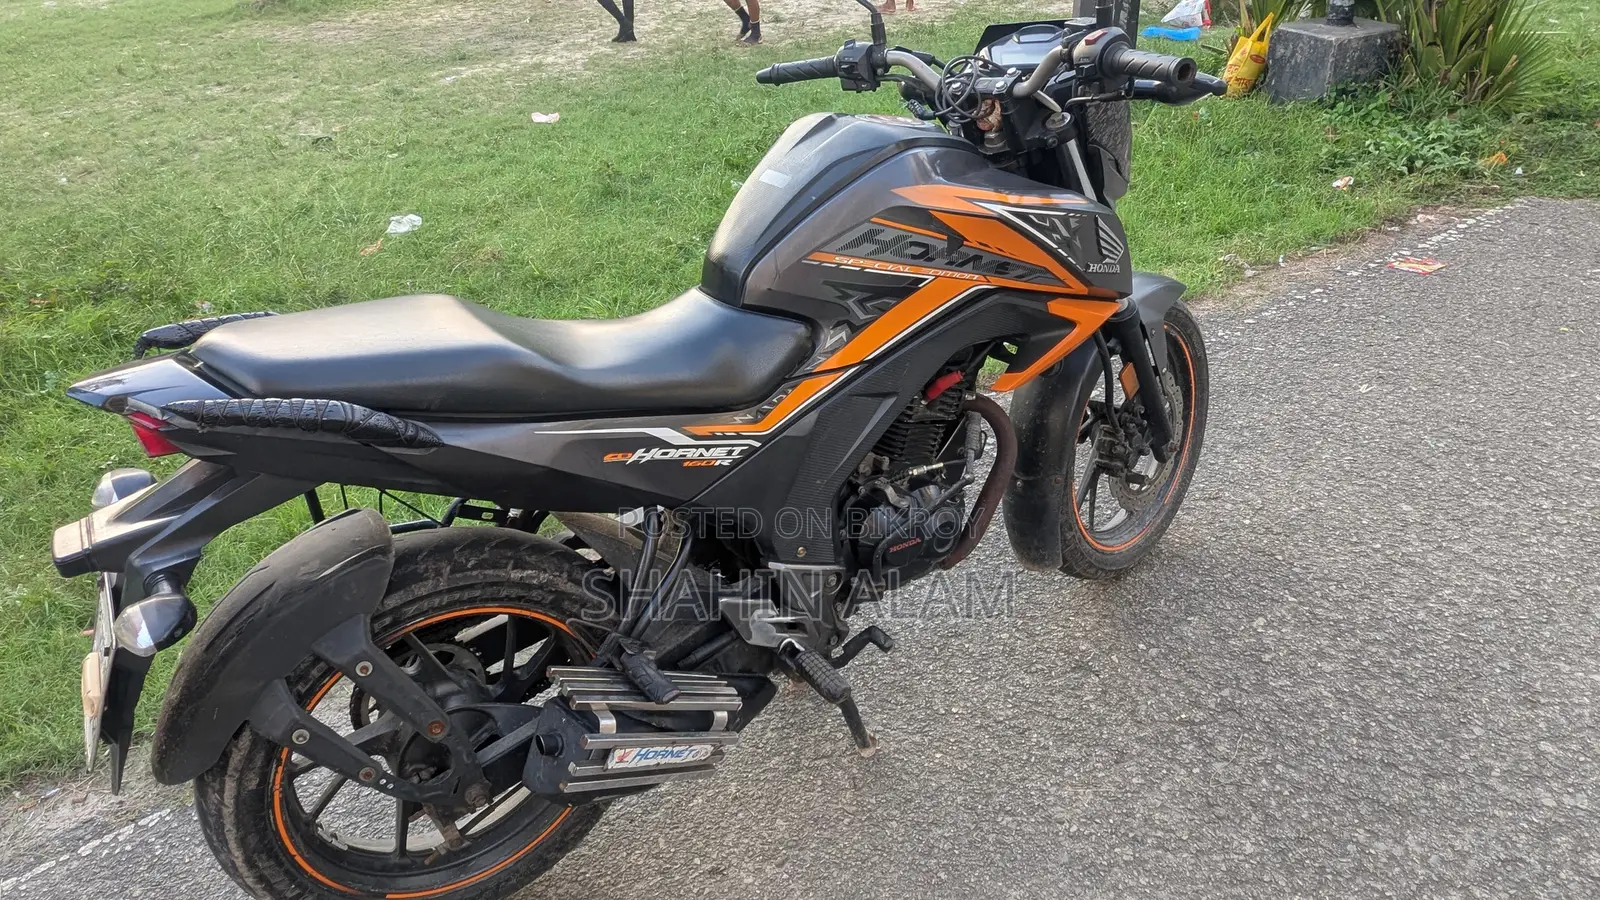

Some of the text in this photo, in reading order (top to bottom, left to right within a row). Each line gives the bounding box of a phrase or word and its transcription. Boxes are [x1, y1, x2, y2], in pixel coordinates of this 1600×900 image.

[1087, 262, 1121, 274] HONDA
[625, 446, 749, 465] HORNET
[682, 459, 733, 467] 160R
[888, 537, 922, 553] HONDA
[628, 746, 696, 765] HORNET
